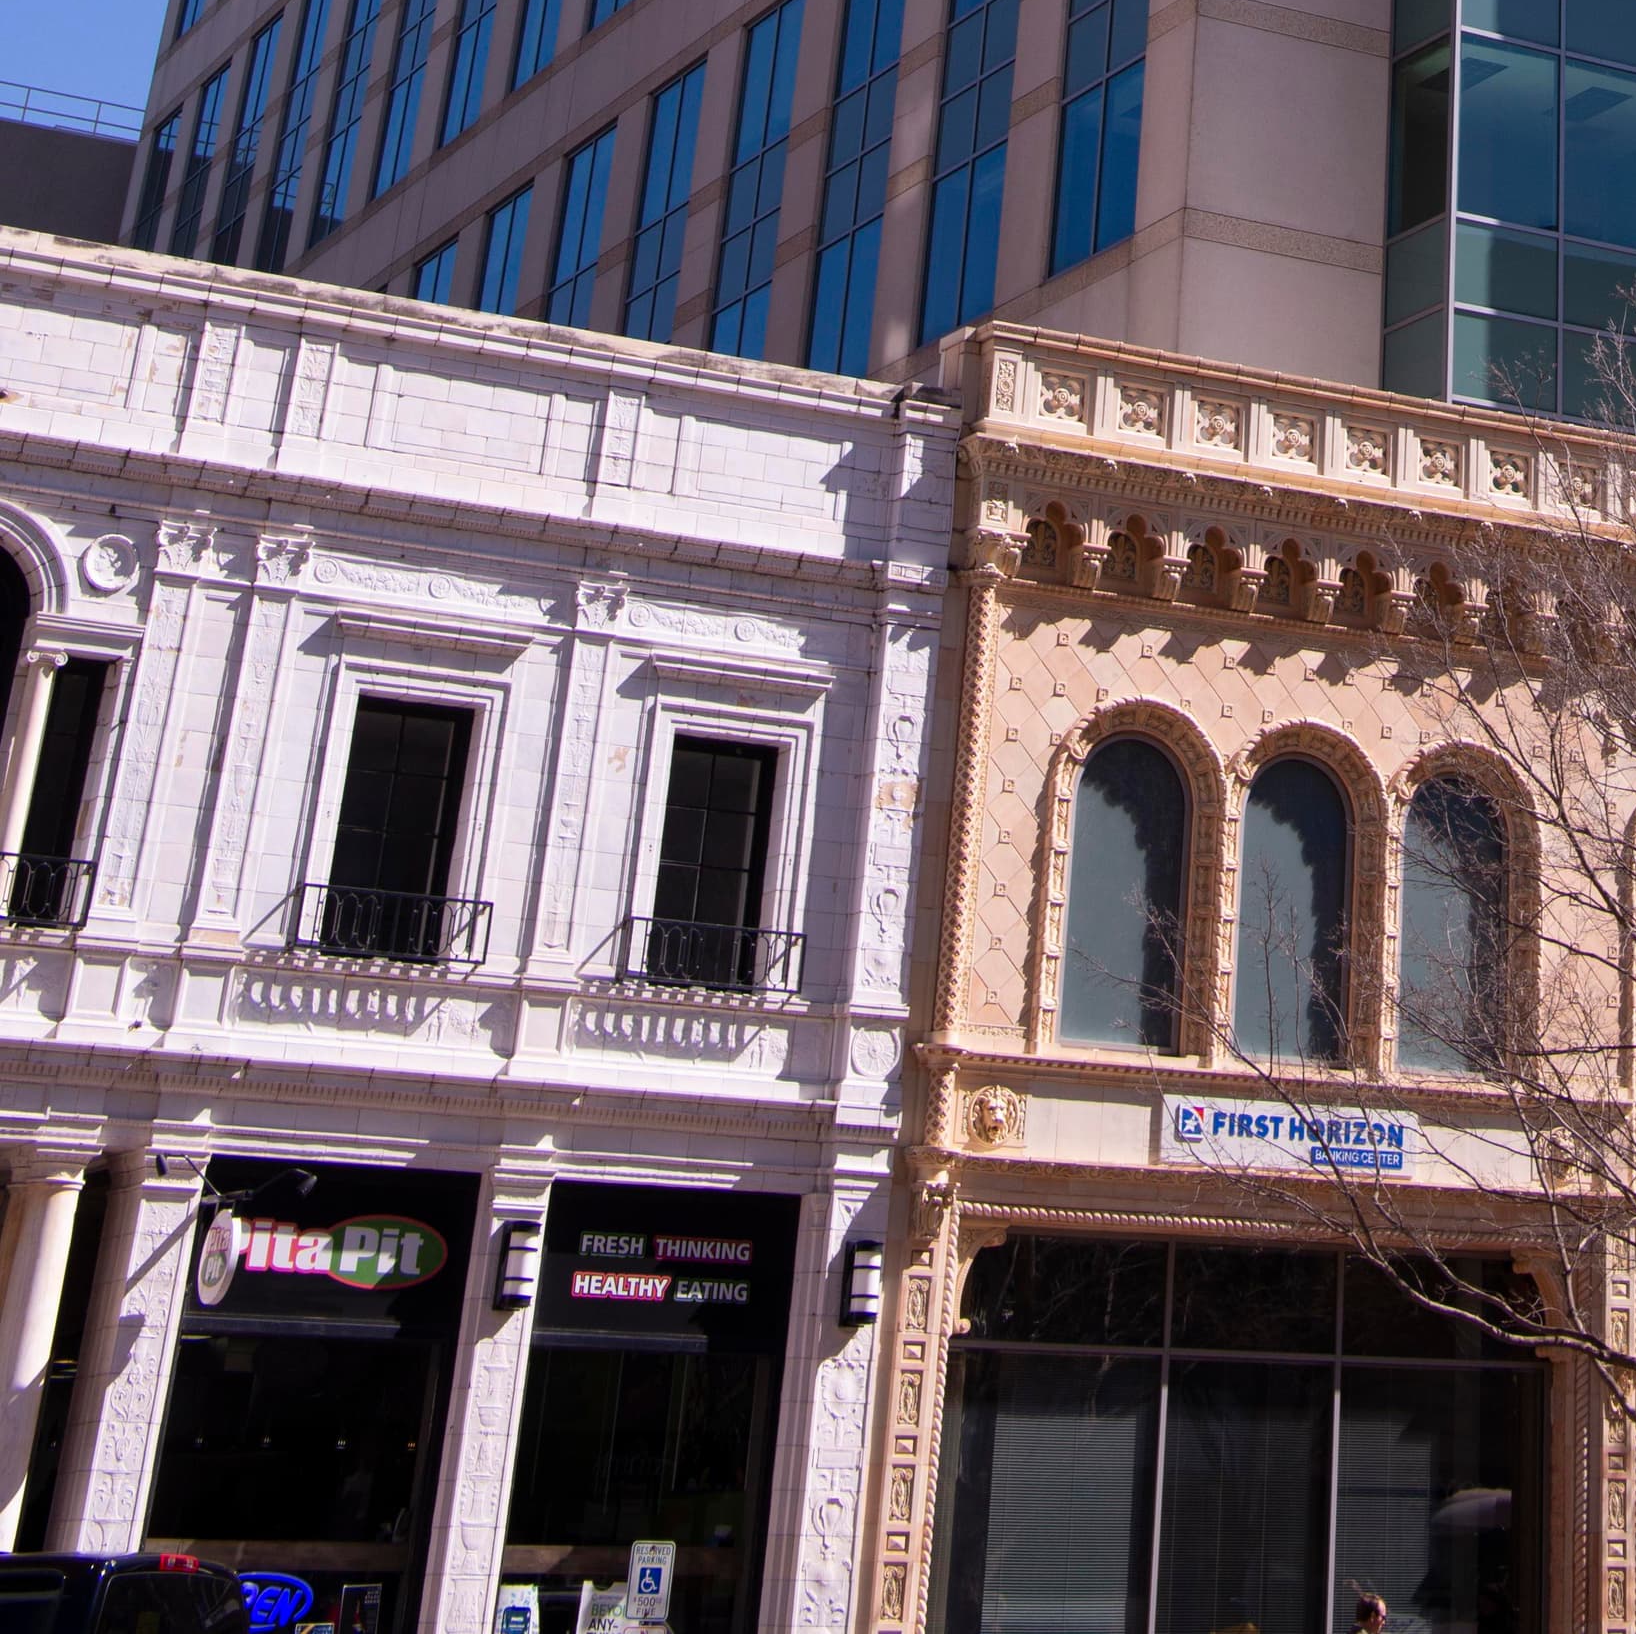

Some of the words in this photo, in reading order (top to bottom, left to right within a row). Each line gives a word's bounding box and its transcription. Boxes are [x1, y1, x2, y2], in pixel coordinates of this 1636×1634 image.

[1212, 1111, 1284, 1140] FIRST
[1289, 1116, 1405, 1148] HORIZON
[206, 1226, 232, 1252] Pita
[338, 1225, 424, 1275] Pit
[581, 1234, 644, 1256] FRESH
[656, 1238, 750, 1261] THINKING
[205, 1257, 222, 1281] Pit
[574, 1274, 669, 1298] HEALTHY
[676, 1280, 748, 1301] EATING
[635, 1545, 672, 1556] RESERVED
[637, 1556, 668, 1565] PARKING
[241, 1581, 303, 1628] PEN
[592, 1604, 626, 1617] BEYO
[636, 1607, 657, 1616] FINE
[588, 1618, 619, 1631] ANY-
